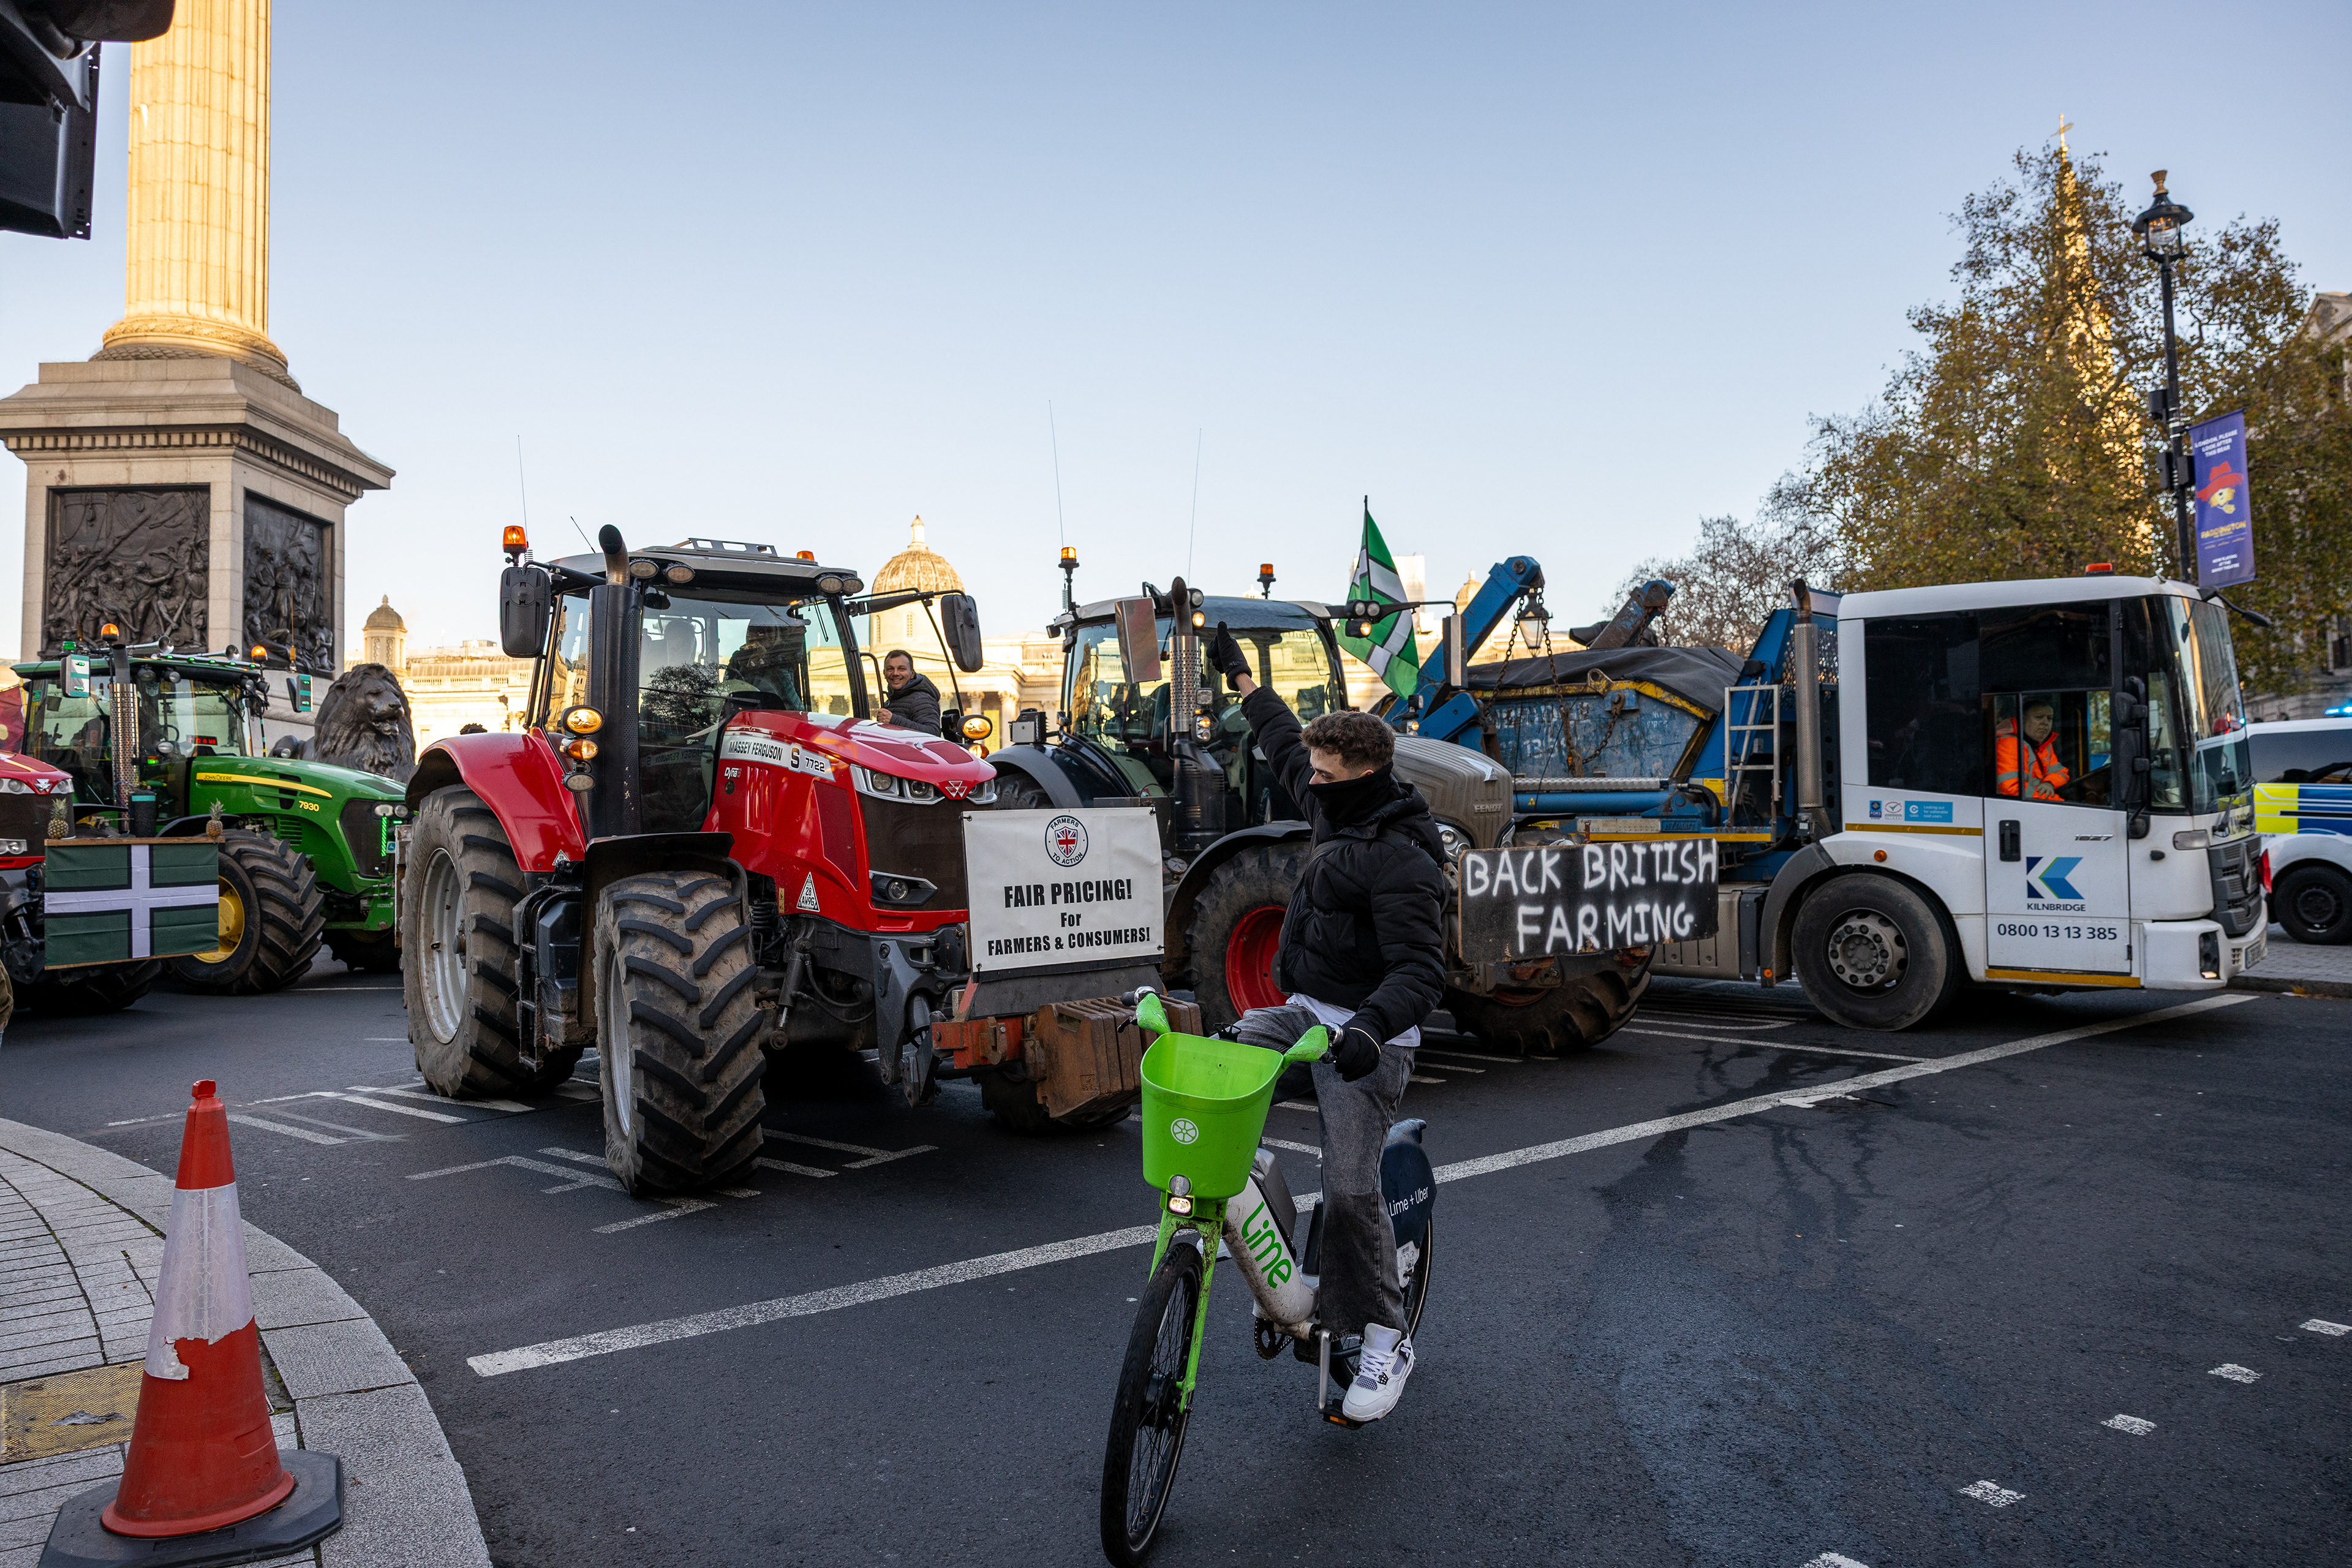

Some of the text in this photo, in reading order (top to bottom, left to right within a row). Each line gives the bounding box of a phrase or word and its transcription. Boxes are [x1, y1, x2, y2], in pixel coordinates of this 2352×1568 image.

[728, 741, 783, 761] MASSEY FERGUSON
[805, 757, 826, 772] 7722
[298, 800, 320, 812] 7930
[1472, 804, 1503, 813] FENDT
[1050, 818, 1079, 830] FARMERS
[1052, 852, 1083, 864] TO ACTION
[1466, 838, 1717, 897] BACK BRITISH
[805, 887, 812, 896] 28
[1004, 878, 1132, 908] FAIR PRICING!
[2027, 903, 2086, 911] KILNBRIDGE
[1060, 912, 1082, 927] For
[1517, 901, 1695, 954] FARMING
[1997, 923, 2117, 940] 0800 13 13 385
[988, 927, 1150, 956] FARMERS & CONSUMERS!
[1389, 1186, 1428, 1217] Lime + Uber
[1241, 1200, 1292, 1289] Lime
